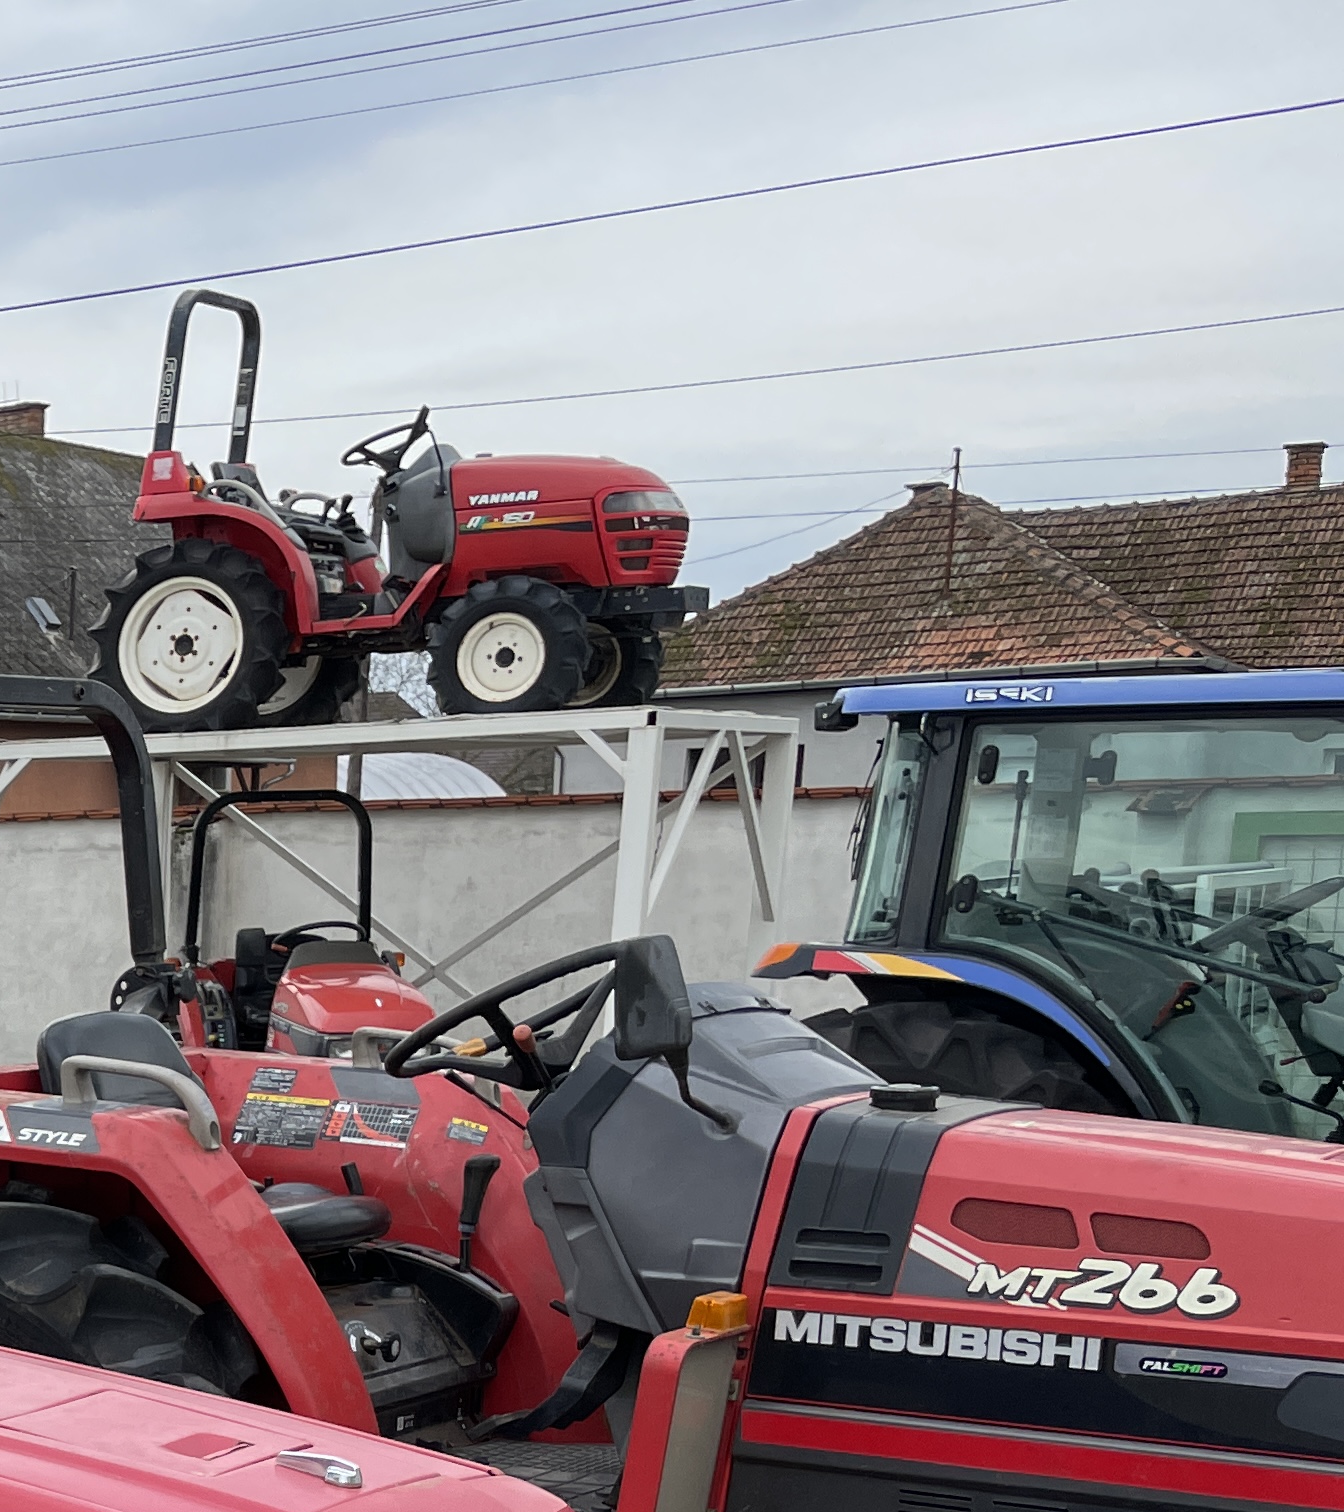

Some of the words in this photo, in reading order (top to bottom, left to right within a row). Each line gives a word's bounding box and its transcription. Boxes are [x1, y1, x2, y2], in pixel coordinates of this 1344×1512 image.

[468, 490, 539, 506] YANMAR
[17, 1128, 87, 1147] STYLE
[774, 1309, 1102, 1371] MITSUBISHI
